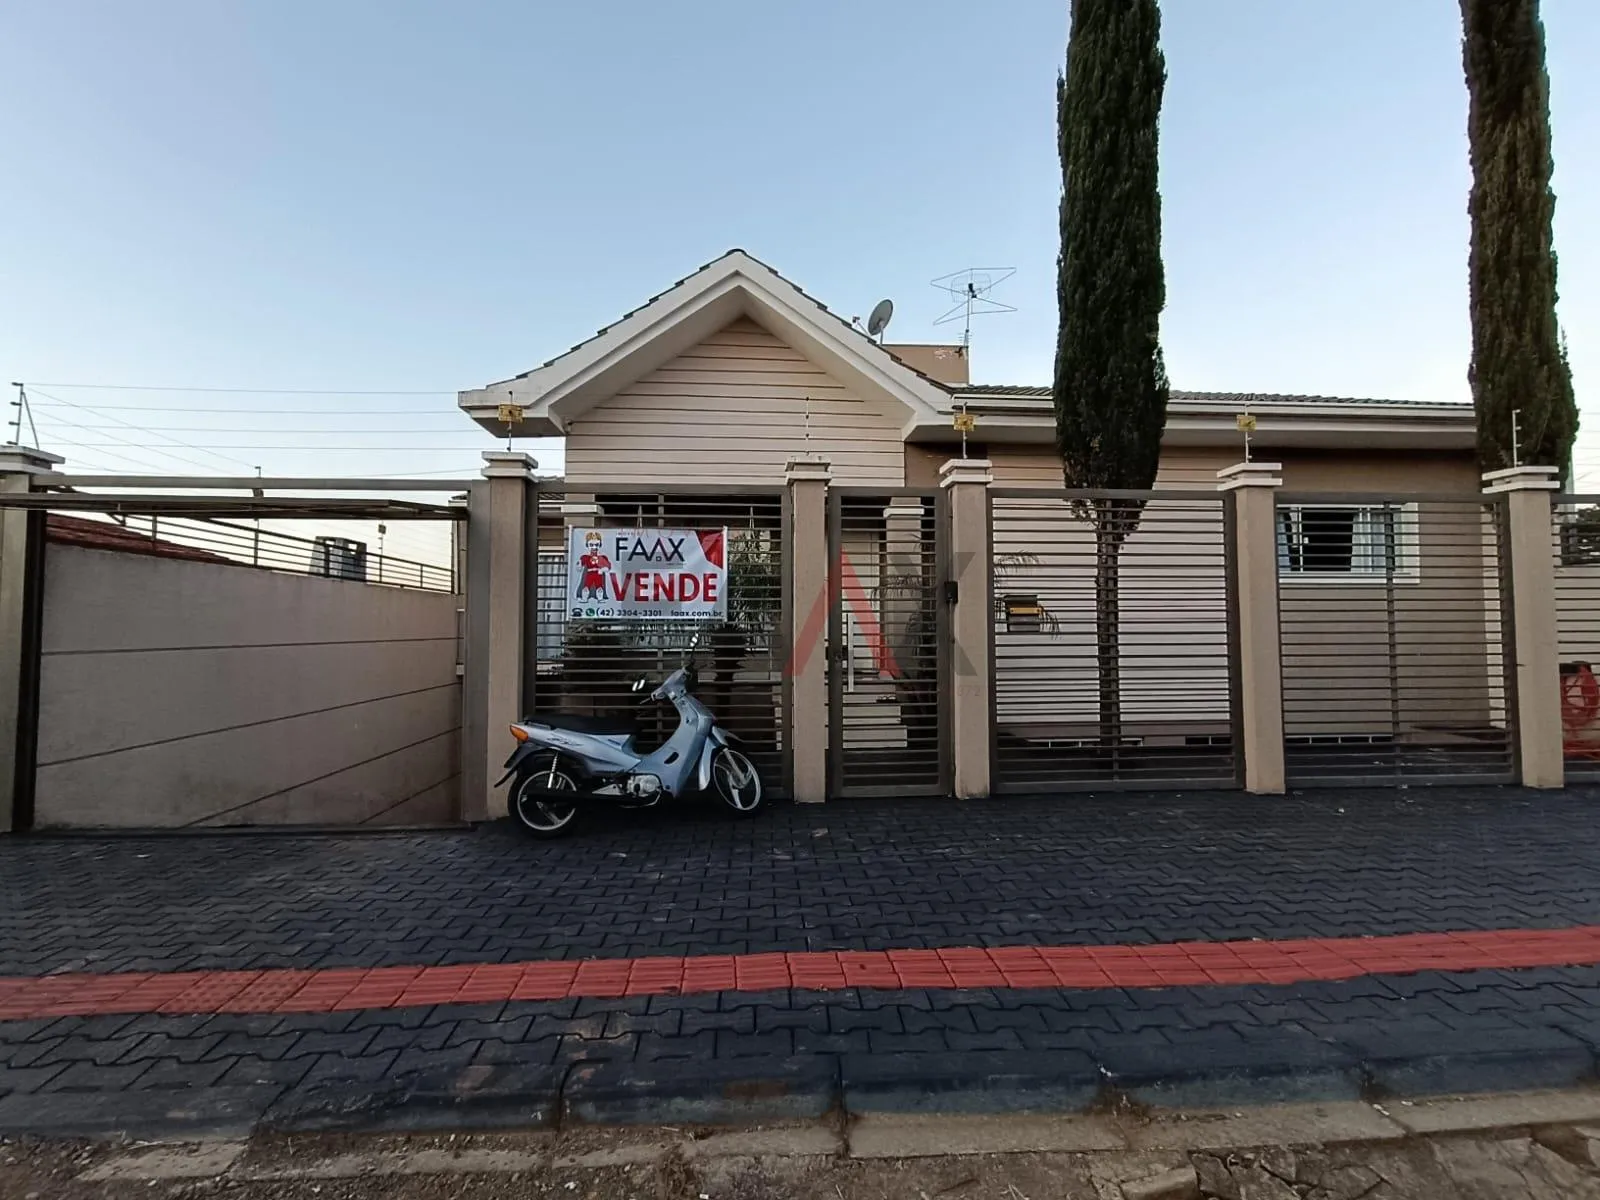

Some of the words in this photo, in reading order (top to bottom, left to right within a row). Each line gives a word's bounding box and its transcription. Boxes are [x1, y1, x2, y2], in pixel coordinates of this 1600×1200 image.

[615, 537, 685, 561] FAAX
[610, 573, 717, 601] VENDE
[596, 607, 615, 617] (42)
